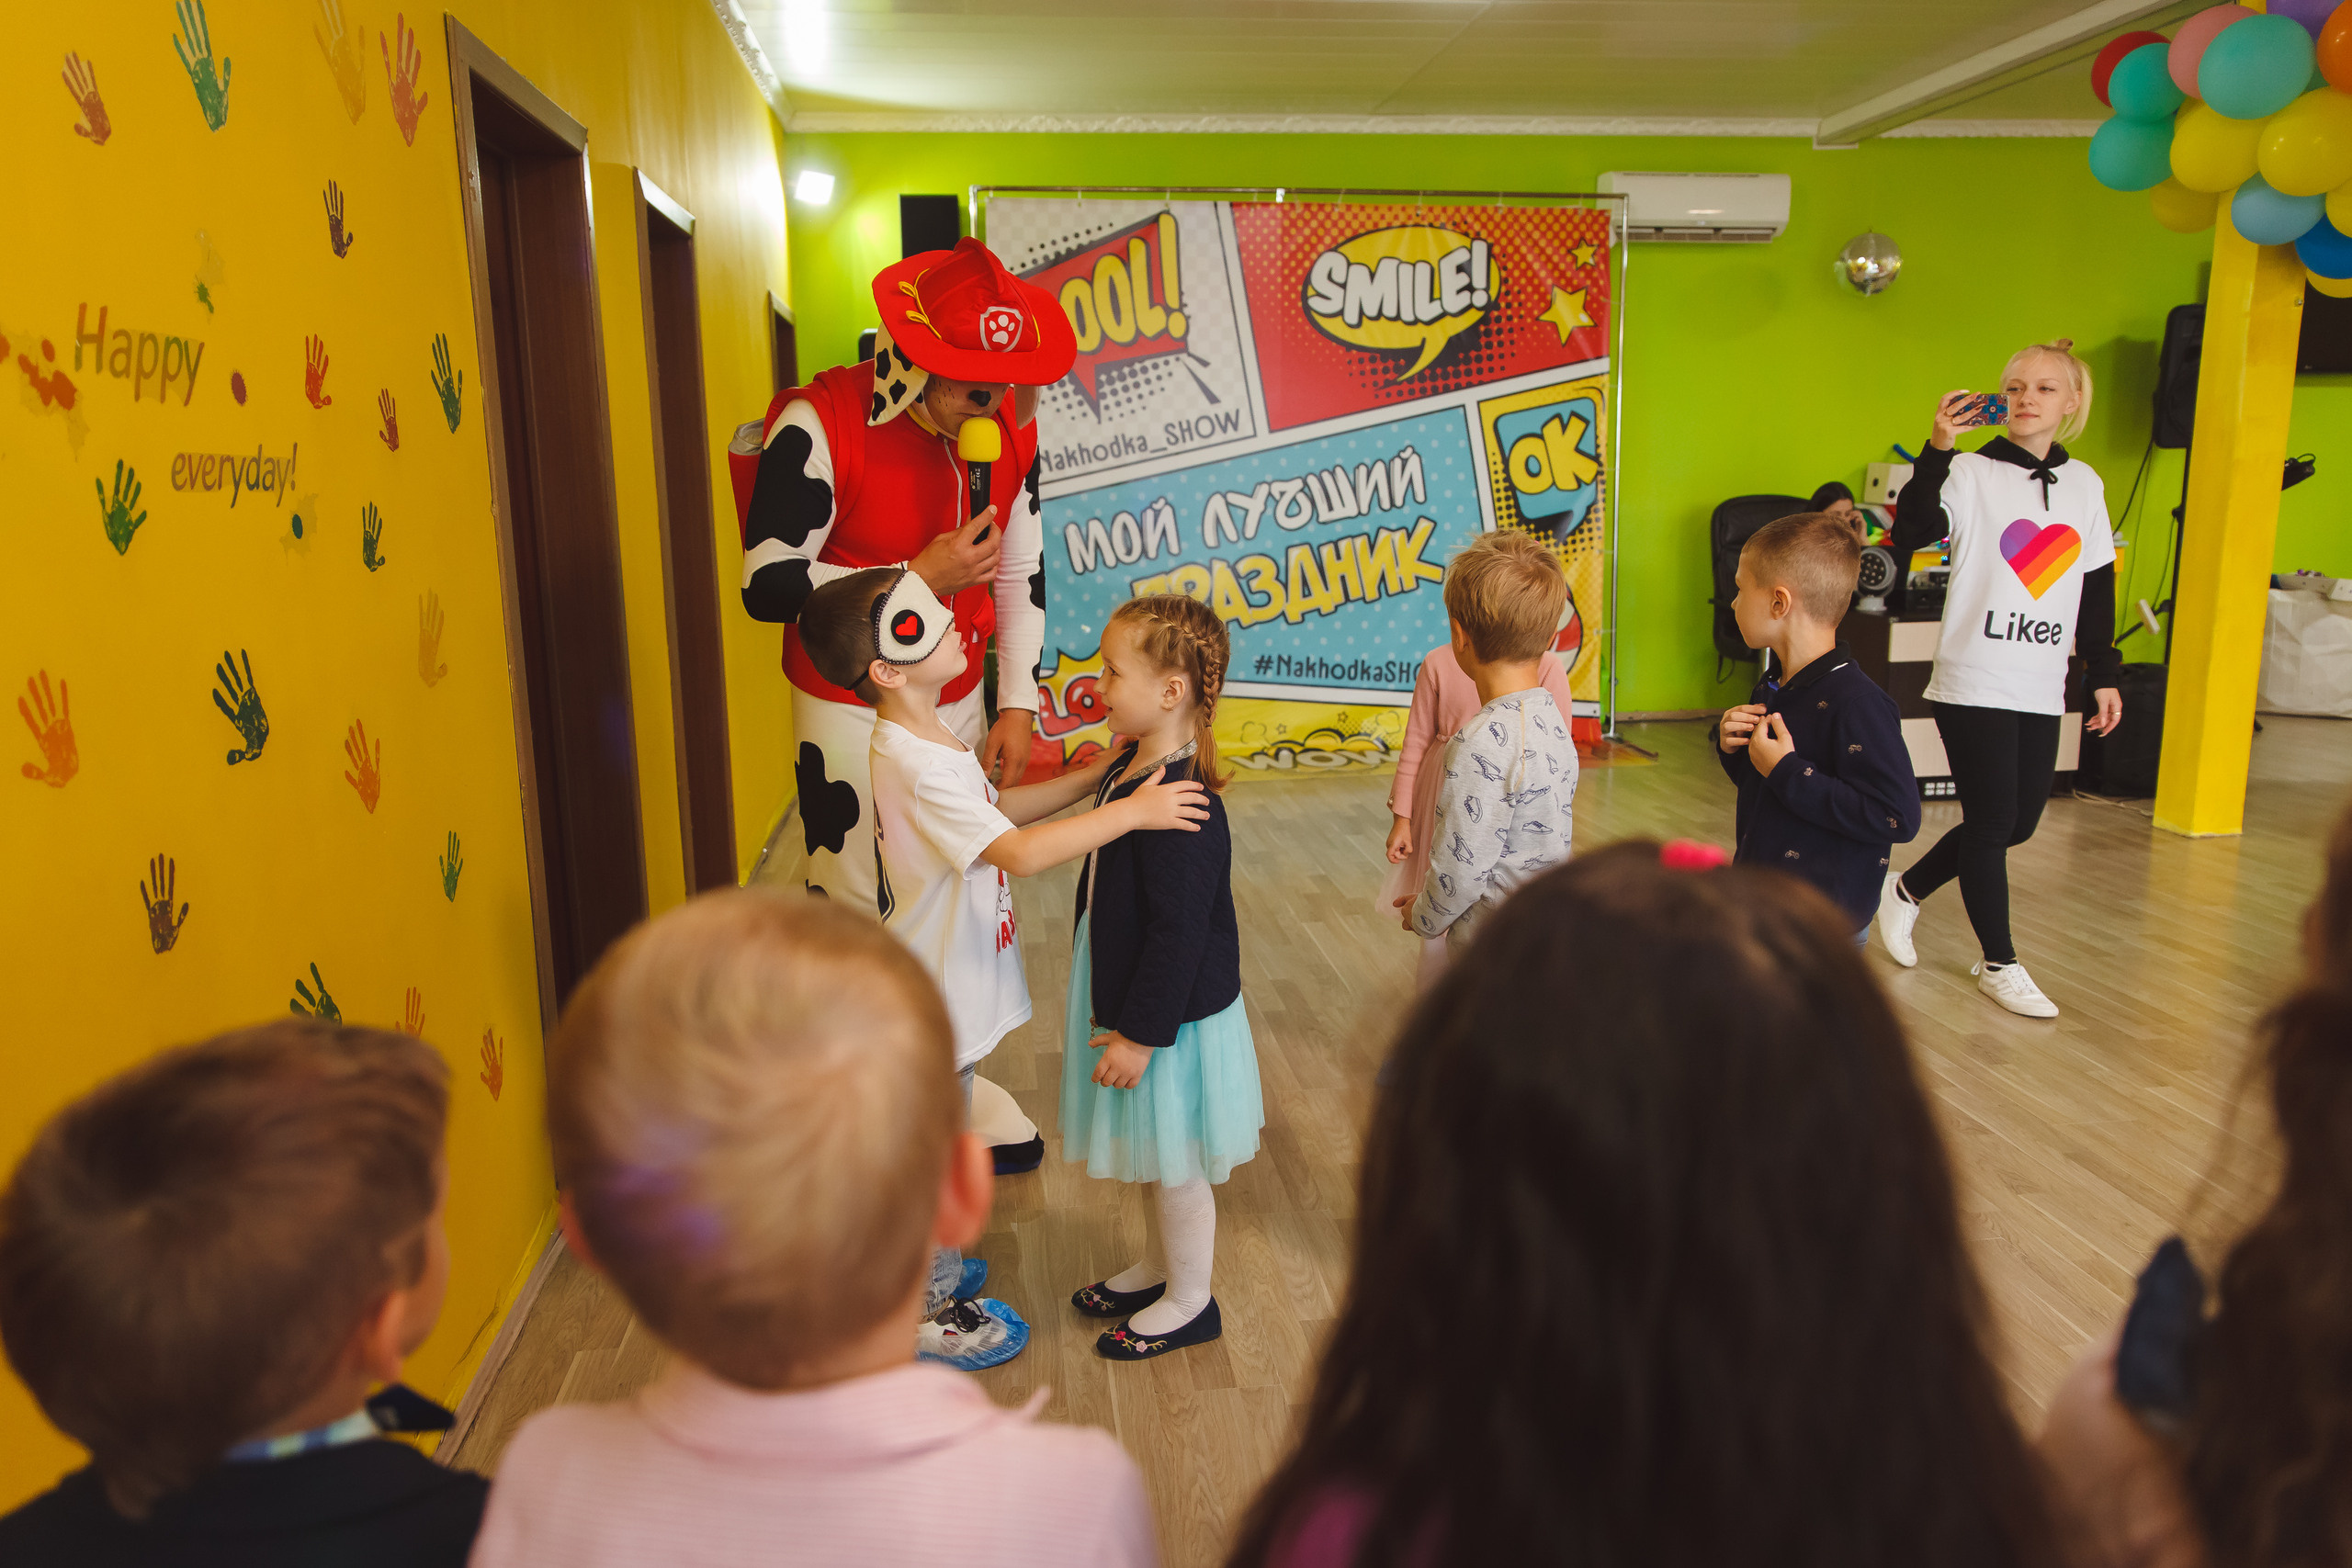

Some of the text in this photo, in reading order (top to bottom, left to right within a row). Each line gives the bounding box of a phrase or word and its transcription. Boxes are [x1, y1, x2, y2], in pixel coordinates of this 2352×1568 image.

[1058, 209, 1189, 355] OOL!
[1306, 238, 1491, 329] SMILE!
[75, 301, 205, 407] Happy
[171, 442, 298, 509] everyday!
[1508, 411, 1600, 495] OK
[1064, 445, 1426, 576] МОЙ ЛУЧШИЙ
[1984, 609, 2064, 646] Likee
[1038, 674, 1107, 738] LO
